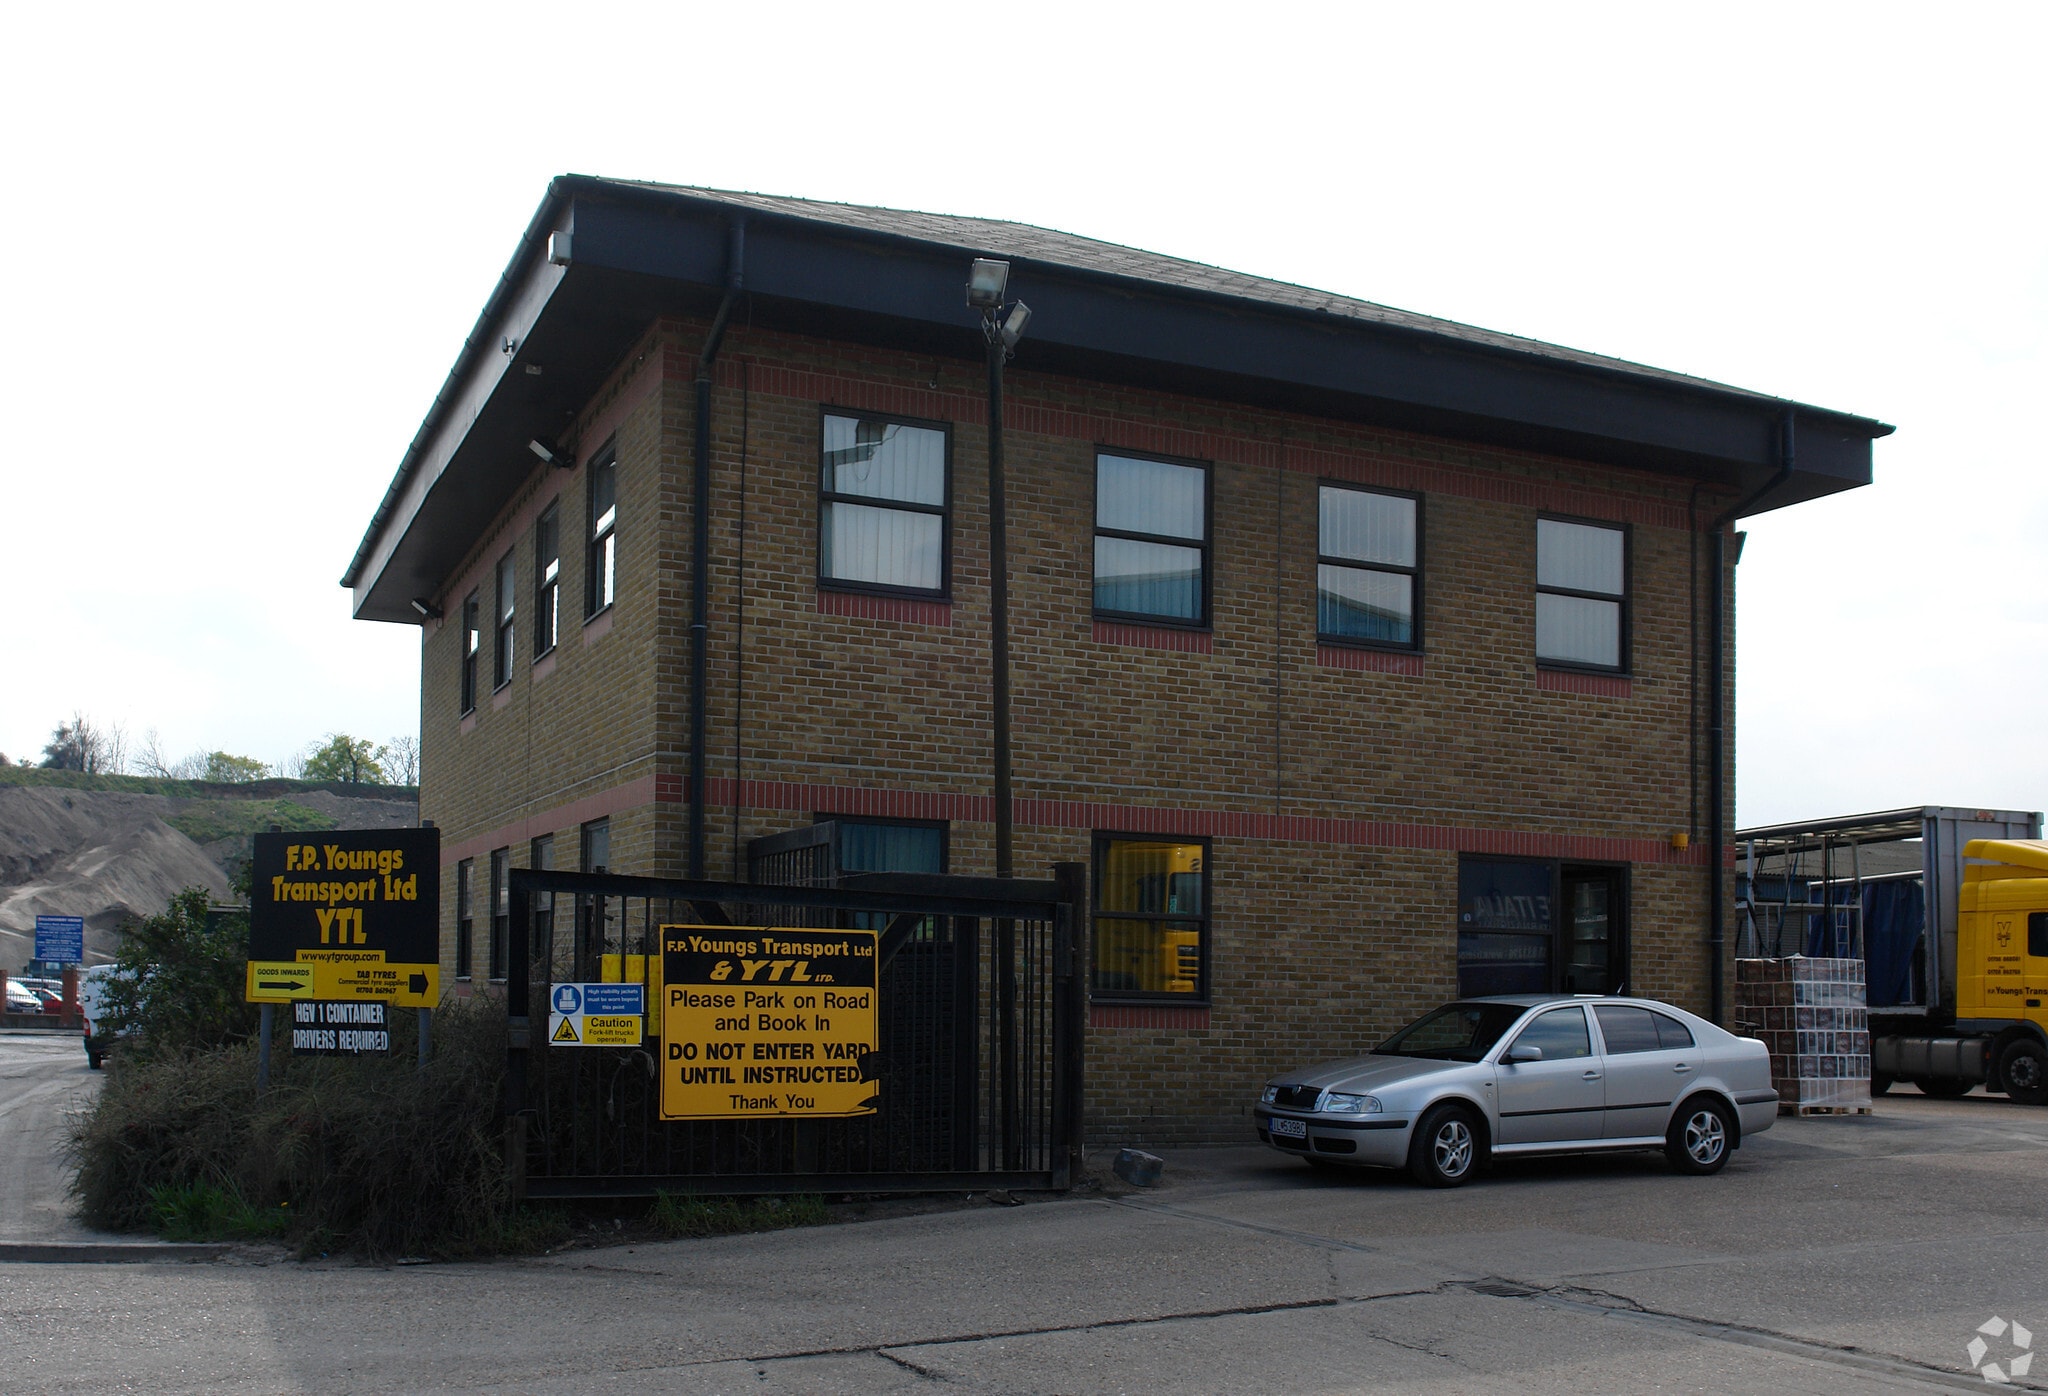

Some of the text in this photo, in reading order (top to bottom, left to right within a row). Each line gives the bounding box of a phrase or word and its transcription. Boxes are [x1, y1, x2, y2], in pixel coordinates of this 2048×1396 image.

[286, 845, 403, 875] F.P. Youngs
[272, 874, 417, 906] Transport Ltd
[315, 907, 367, 944] YTL
[666, 936, 873, 958] F.P. Youngs Transport Ltd
[280, 969, 310, 977] INWARDS
[357, 970, 397, 979] TAB TYRES
[710, 960, 835, 983] & YTL LTD.
[338, 978, 408, 988] Commercial tyre suppliers
[1995, 986, 2023, 996] Youngs
[671, 990, 870, 1009] Please Park on Road
[295, 1003, 384, 1024] HGV 1 CONTAINER
[591, 1017, 633, 1028] Caution
[715, 1014, 830, 1031] and Book In
[293, 1029, 388, 1054] DRIVERS REQUIRED
[668, 1042, 870, 1060] DO NOT ENTER YARD
[681, 1066, 860, 1084] UNTIL INSTRUCTED
[729, 1094, 815, 1109] Thank You
